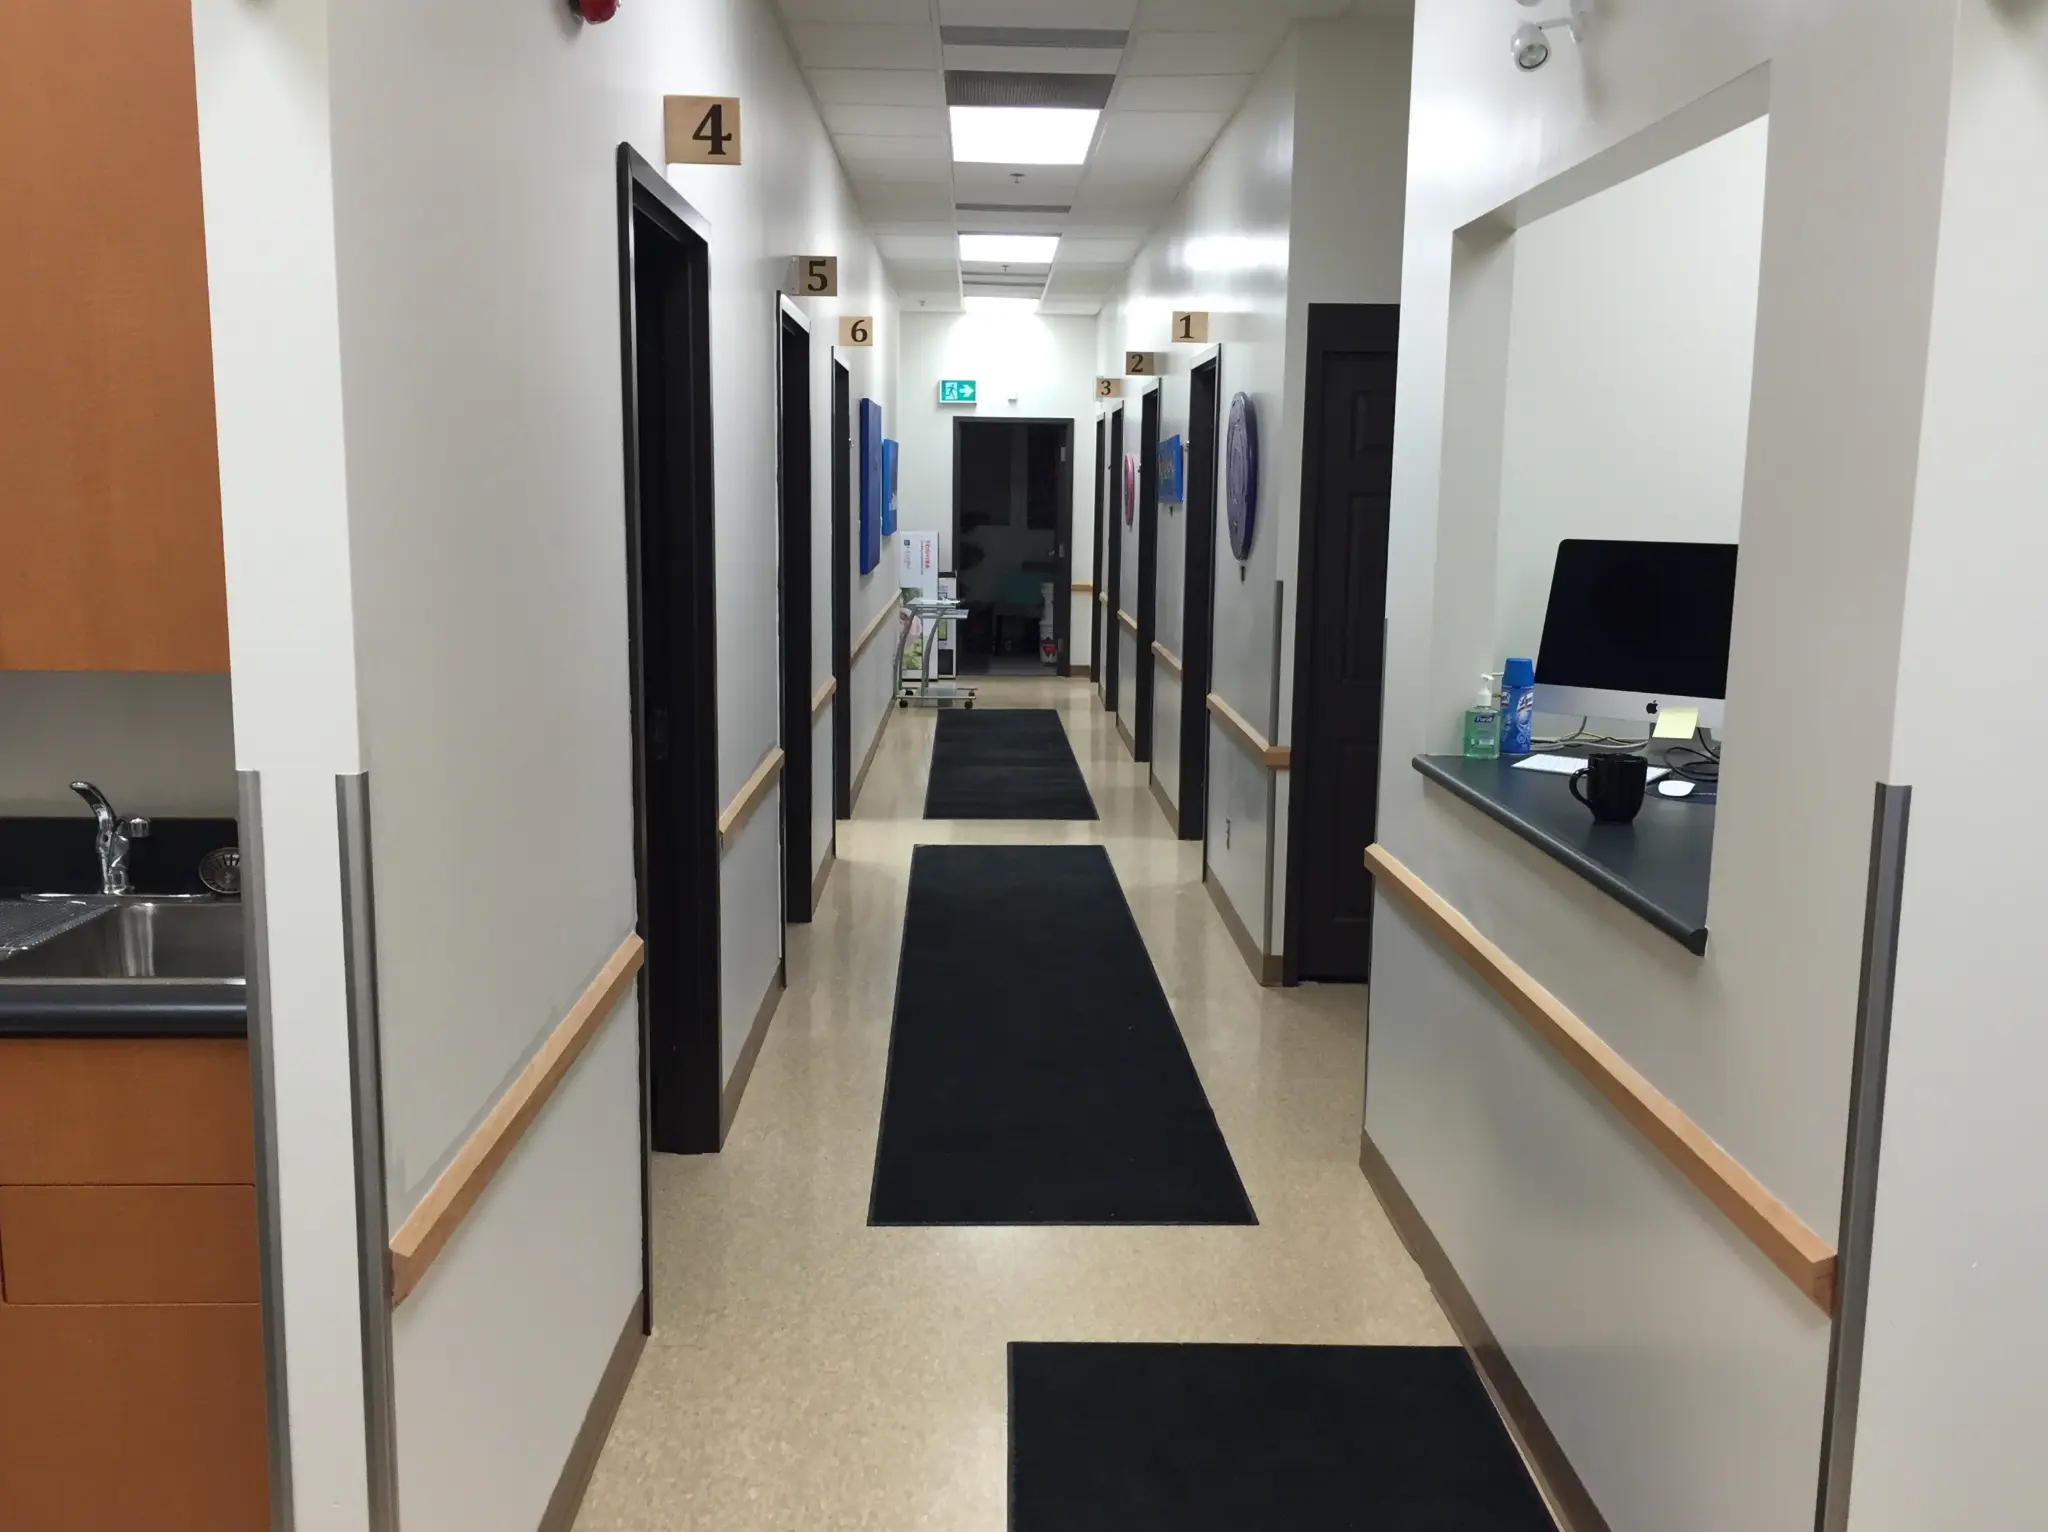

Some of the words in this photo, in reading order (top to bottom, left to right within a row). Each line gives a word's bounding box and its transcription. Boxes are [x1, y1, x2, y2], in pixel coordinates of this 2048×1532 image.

[692, 104, 732, 155] 4
[807, 259, 828, 292] 5
[850, 319, 868, 342] 6
[1179, 314, 1194, 339] 1
[1131, 354, 1144, 373] 2
[1101, 380, 1111, 395] 3
